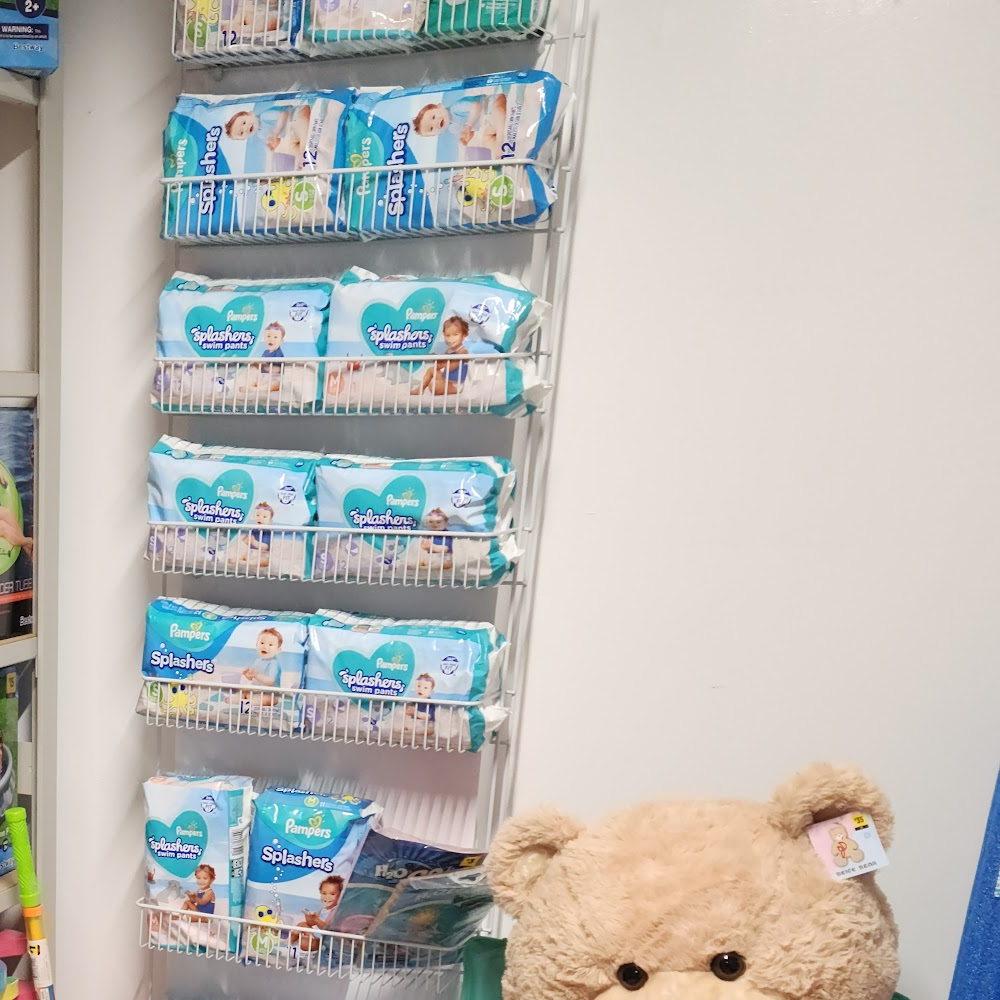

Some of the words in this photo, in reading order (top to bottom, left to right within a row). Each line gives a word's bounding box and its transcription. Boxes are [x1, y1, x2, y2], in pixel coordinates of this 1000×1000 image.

[222, 30, 237, 46] 12
[13, 43, 44, 52] Bestway
[502, 141, 517, 160] 12
[302, 150, 317, 169] 12
[227, 309, 258, 323] Pampers
[405, 308, 438, 322] Pampers
[190, 324, 255, 344] splashers
[367, 324, 433, 344] splashers
[202, 341, 222, 350] swim
[223, 342, 248, 351] pants
[379, 341, 400, 350] swim
[402, 341, 427, 351] pants
[216, 485, 248, 500] Pampers
[385, 493, 420, 508] Pampers
[182, 497, 244, 518] splashers
[193, 513, 213, 522] swim
[214, 515, 238, 524] pants
[350, 508, 417, 528] splashers
[170, 625, 211, 642] Pampers
[151, 650, 215, 674] Splashers
[376, 655, 408, 672] Pampers
[340, 670, 405, 691] splashers
[351, 686, 372, 694] swim
[374, 687, 399, 697] pants
[176, 825, 203, 838] Pampers
[285, 818, 331, 839] Pampers
[149, 838, 202, 856] splashers
[157, 850, 176, 859] swim
[177, 851, 197, 860] pants
[261, 846, 335, 873] Splashers
